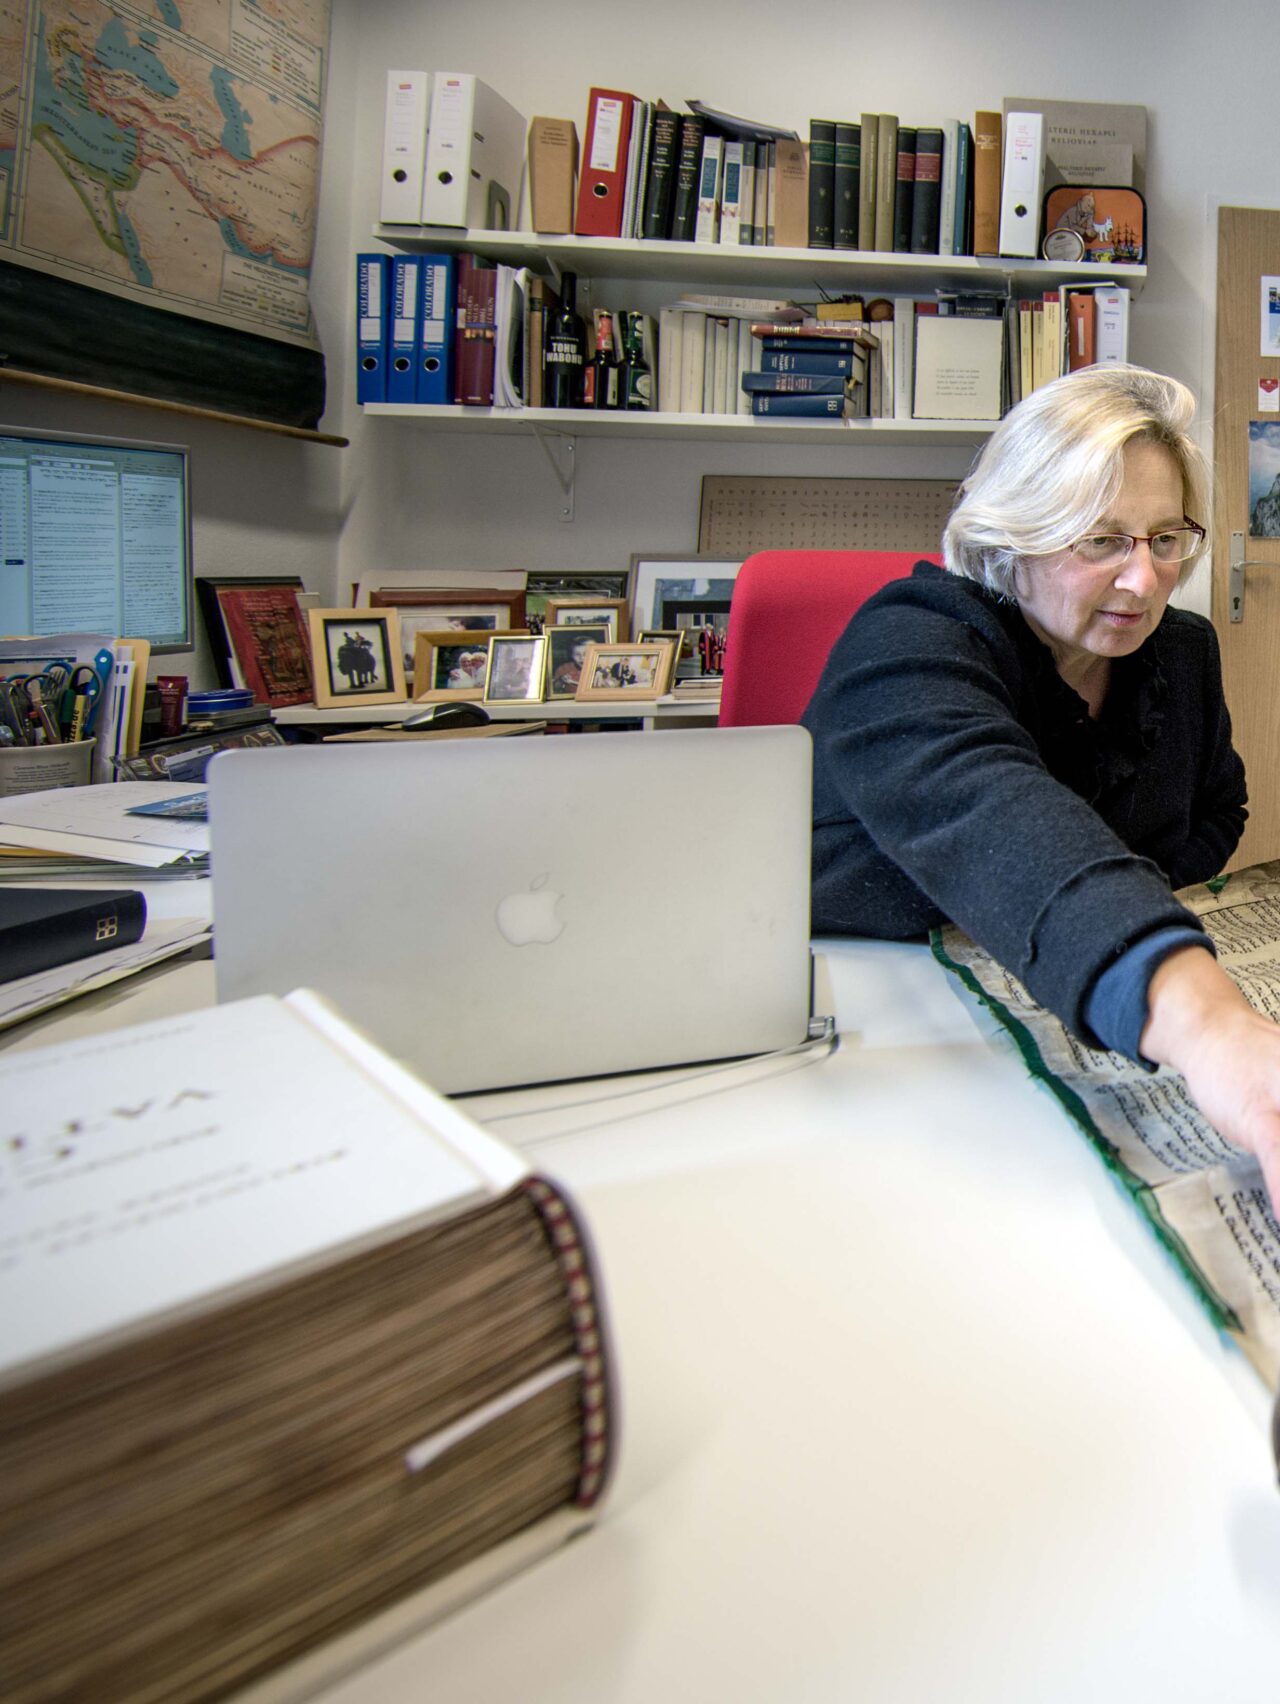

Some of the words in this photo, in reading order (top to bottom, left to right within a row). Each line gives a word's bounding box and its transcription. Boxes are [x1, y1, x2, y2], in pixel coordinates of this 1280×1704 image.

[360, 263, 368, 317] COLORADO
[394, 264, 404, 318] COLORADO
[424, 265, 434, 319] COLORADO
[546, 352, 583, 365] WABOHU
[552, 343, 577, 353] TOHU
